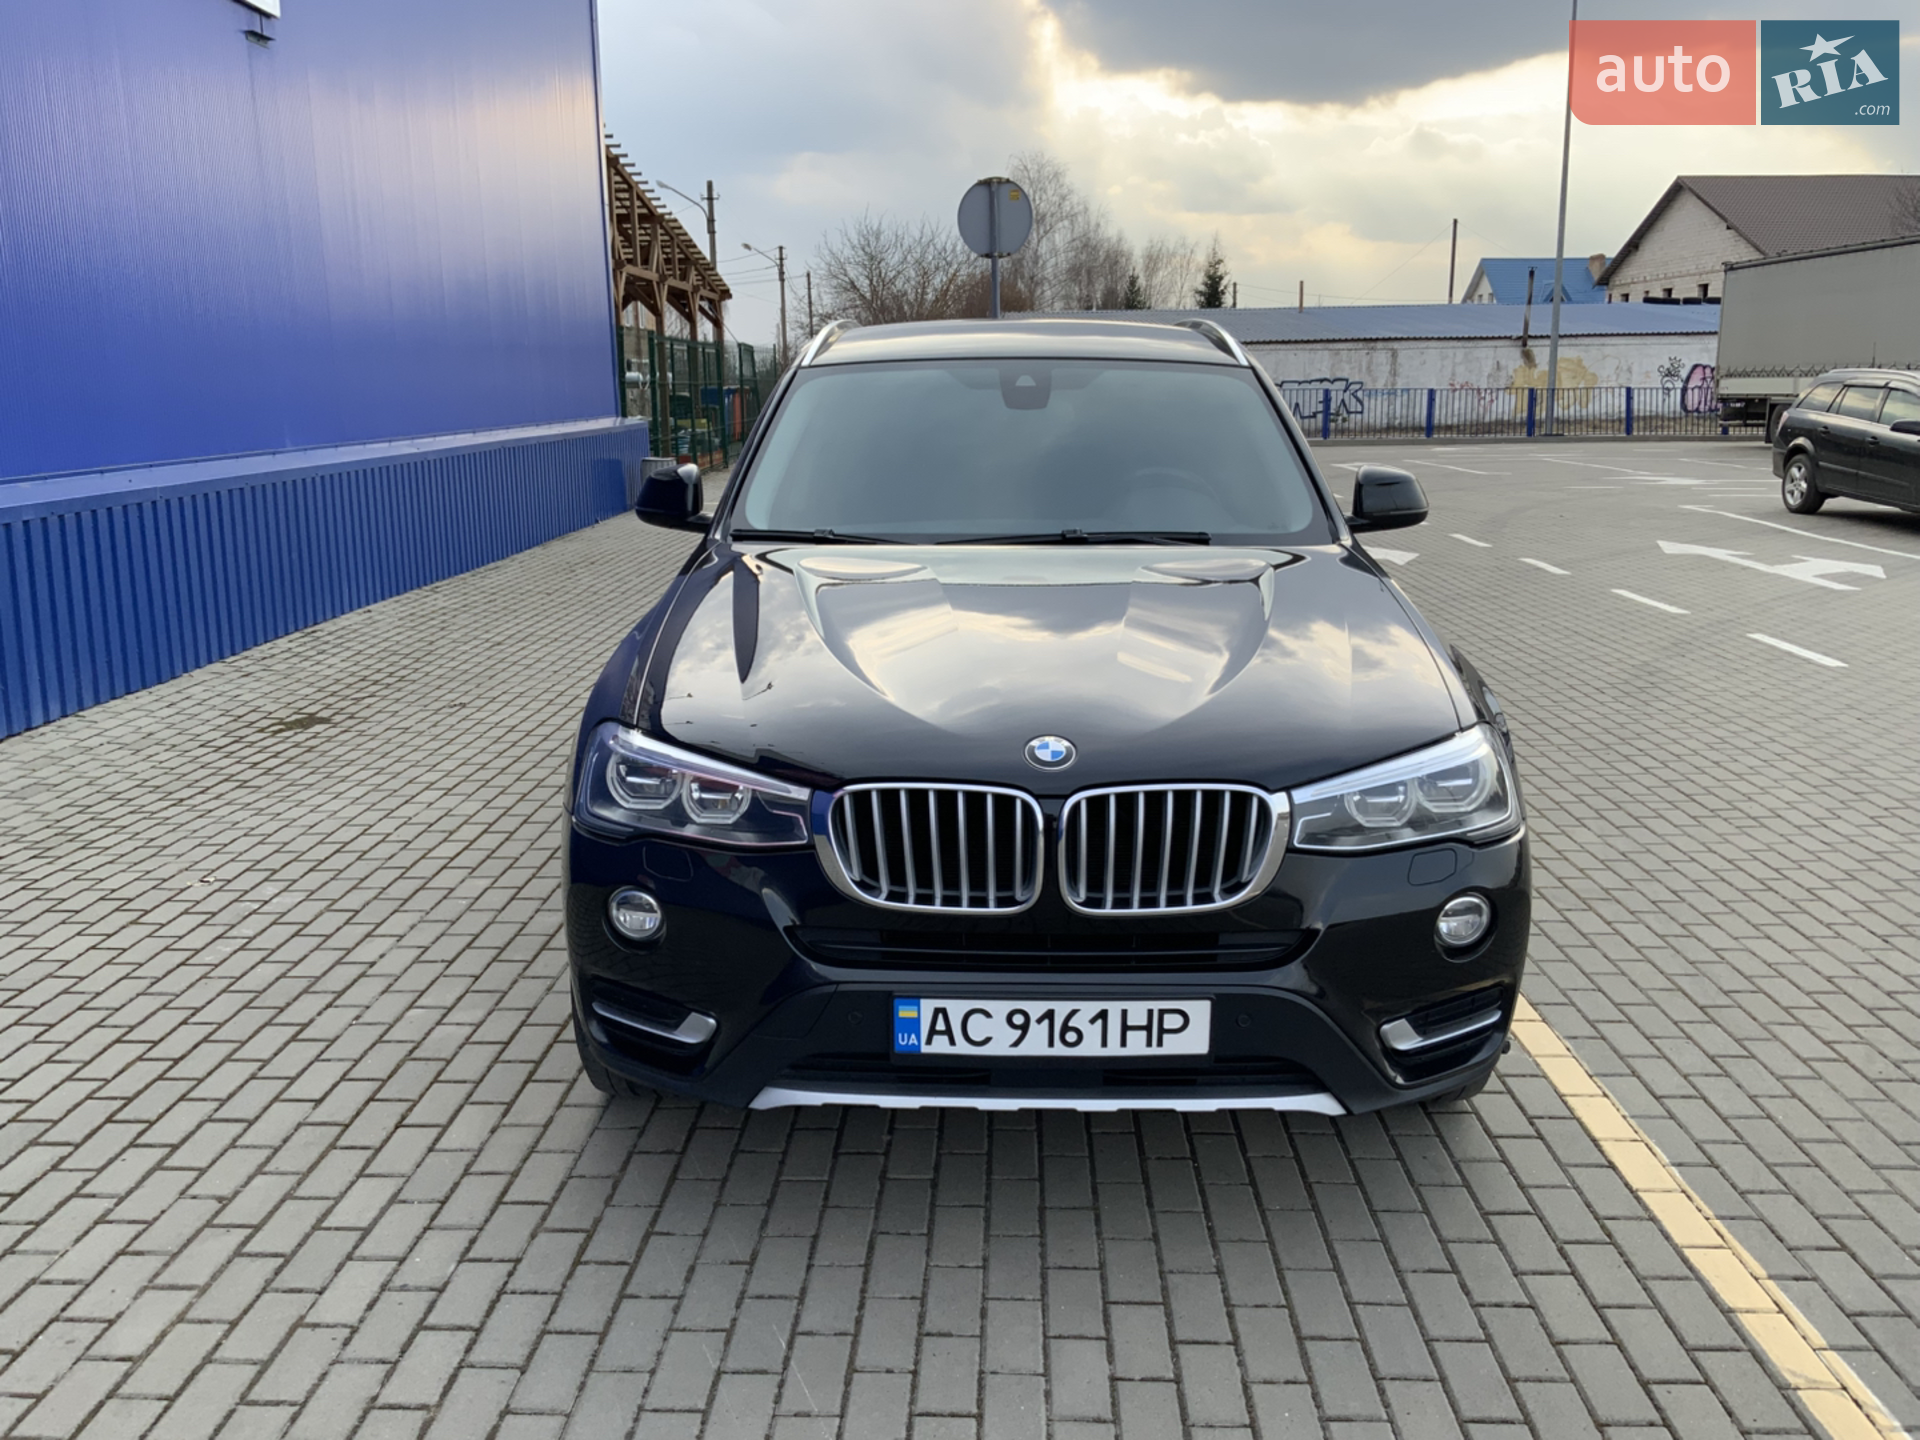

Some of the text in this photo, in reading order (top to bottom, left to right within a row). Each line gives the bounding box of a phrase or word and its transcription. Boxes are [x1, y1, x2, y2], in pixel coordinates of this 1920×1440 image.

[897, 1033, 919, 1046] UA
[924, 1007, 1191, 1049] AC 9161 HP
